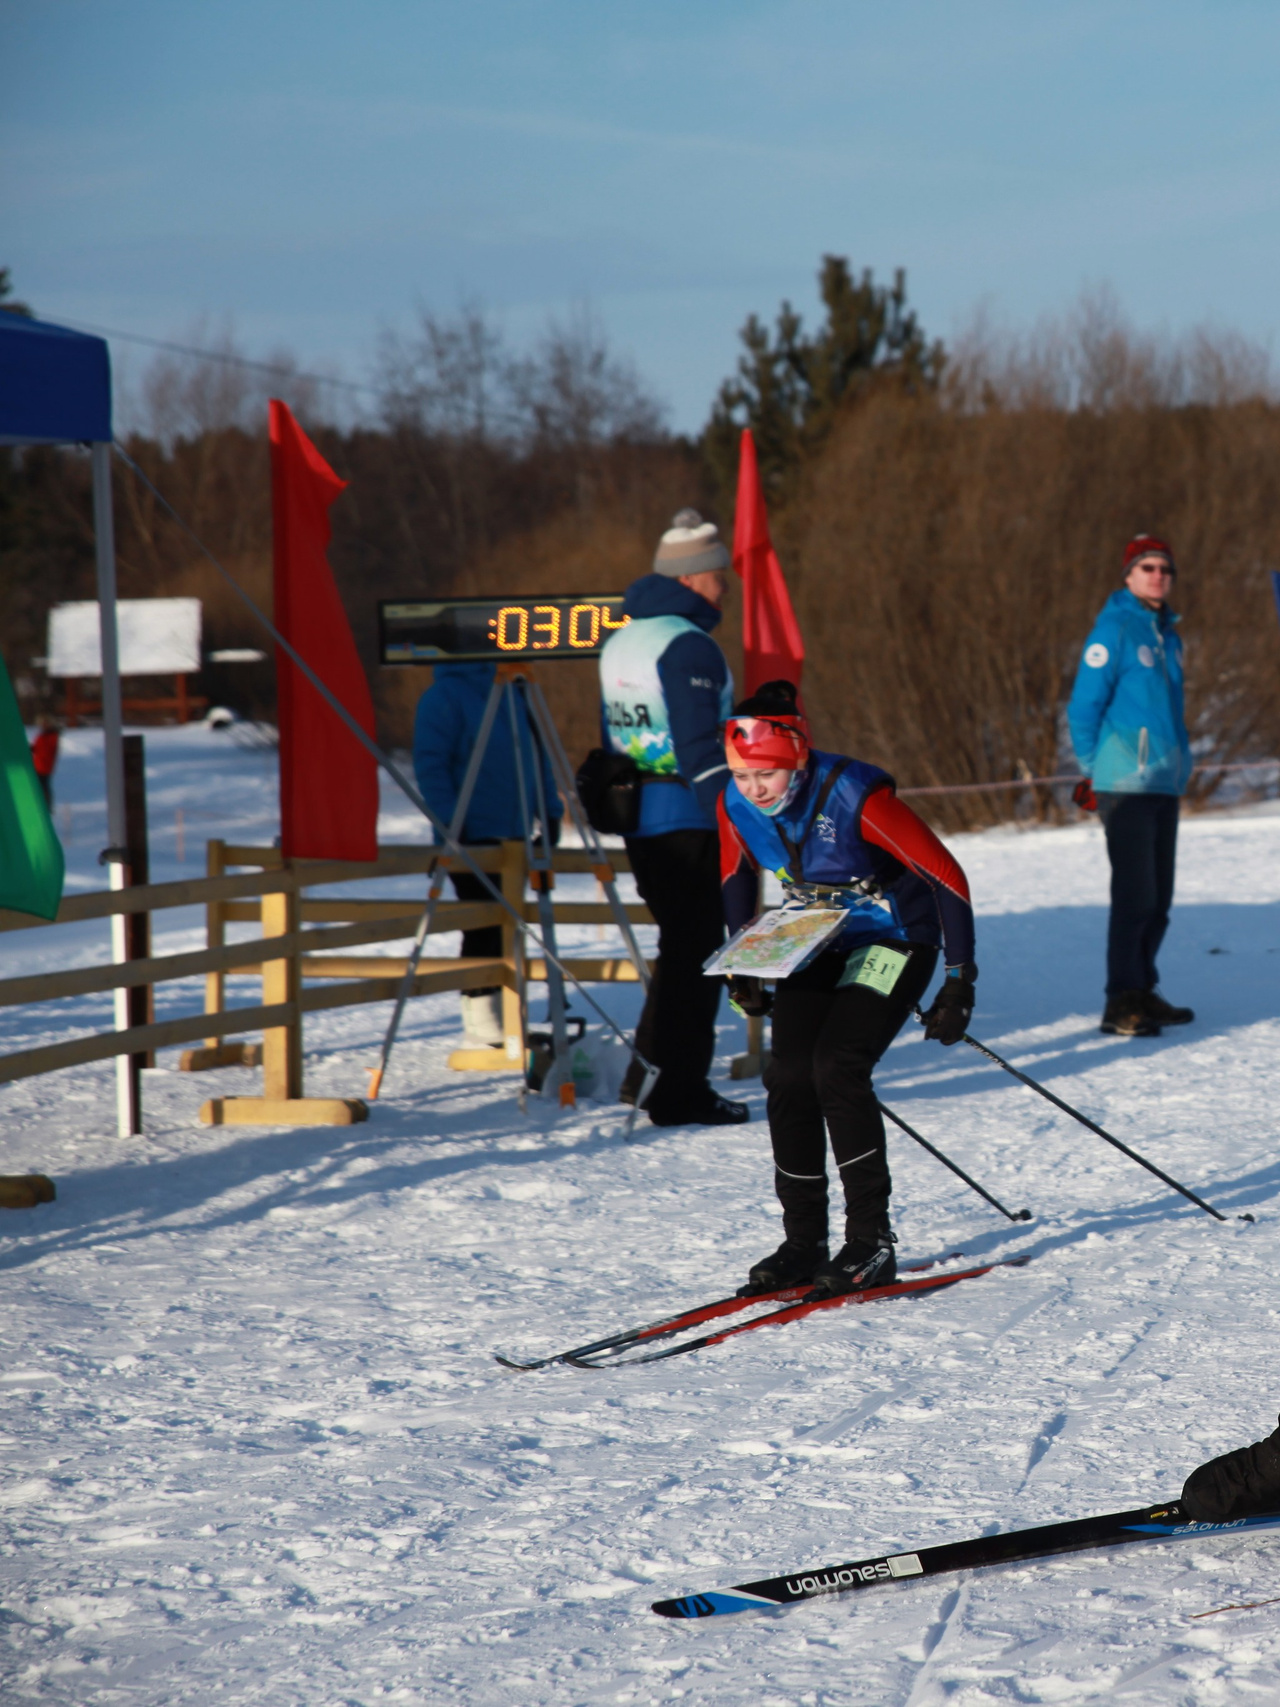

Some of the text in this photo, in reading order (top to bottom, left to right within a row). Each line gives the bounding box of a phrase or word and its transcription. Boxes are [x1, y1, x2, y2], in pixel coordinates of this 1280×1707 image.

[777, 1289, 798, 1300] TISA
[844, 1294, 865, 1304] TISA
[786, 1562, 891, 1595] salomon
